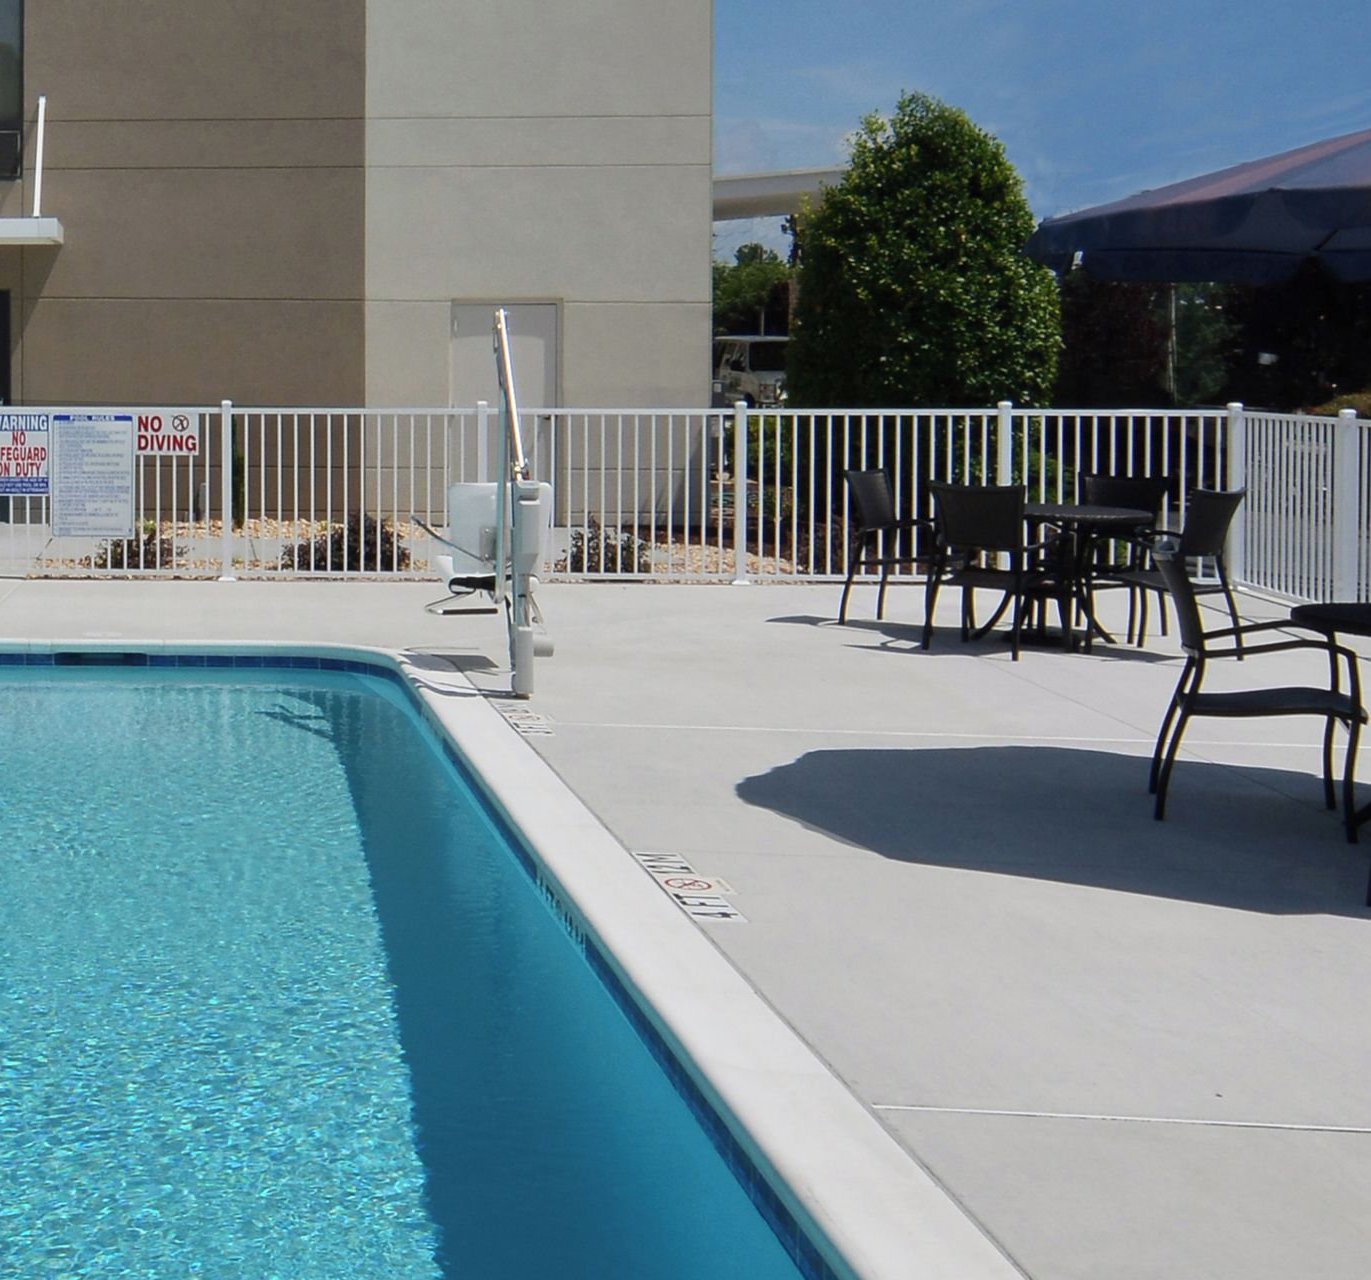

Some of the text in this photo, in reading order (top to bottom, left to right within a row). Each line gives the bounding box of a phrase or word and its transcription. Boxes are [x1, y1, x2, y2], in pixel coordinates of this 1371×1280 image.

[137, 416, 162, 433] NO
[11, 431, 26, 446] NO
[137, 434, 197, 452] DIVING
[15, 462, 42, 477] DUTY
